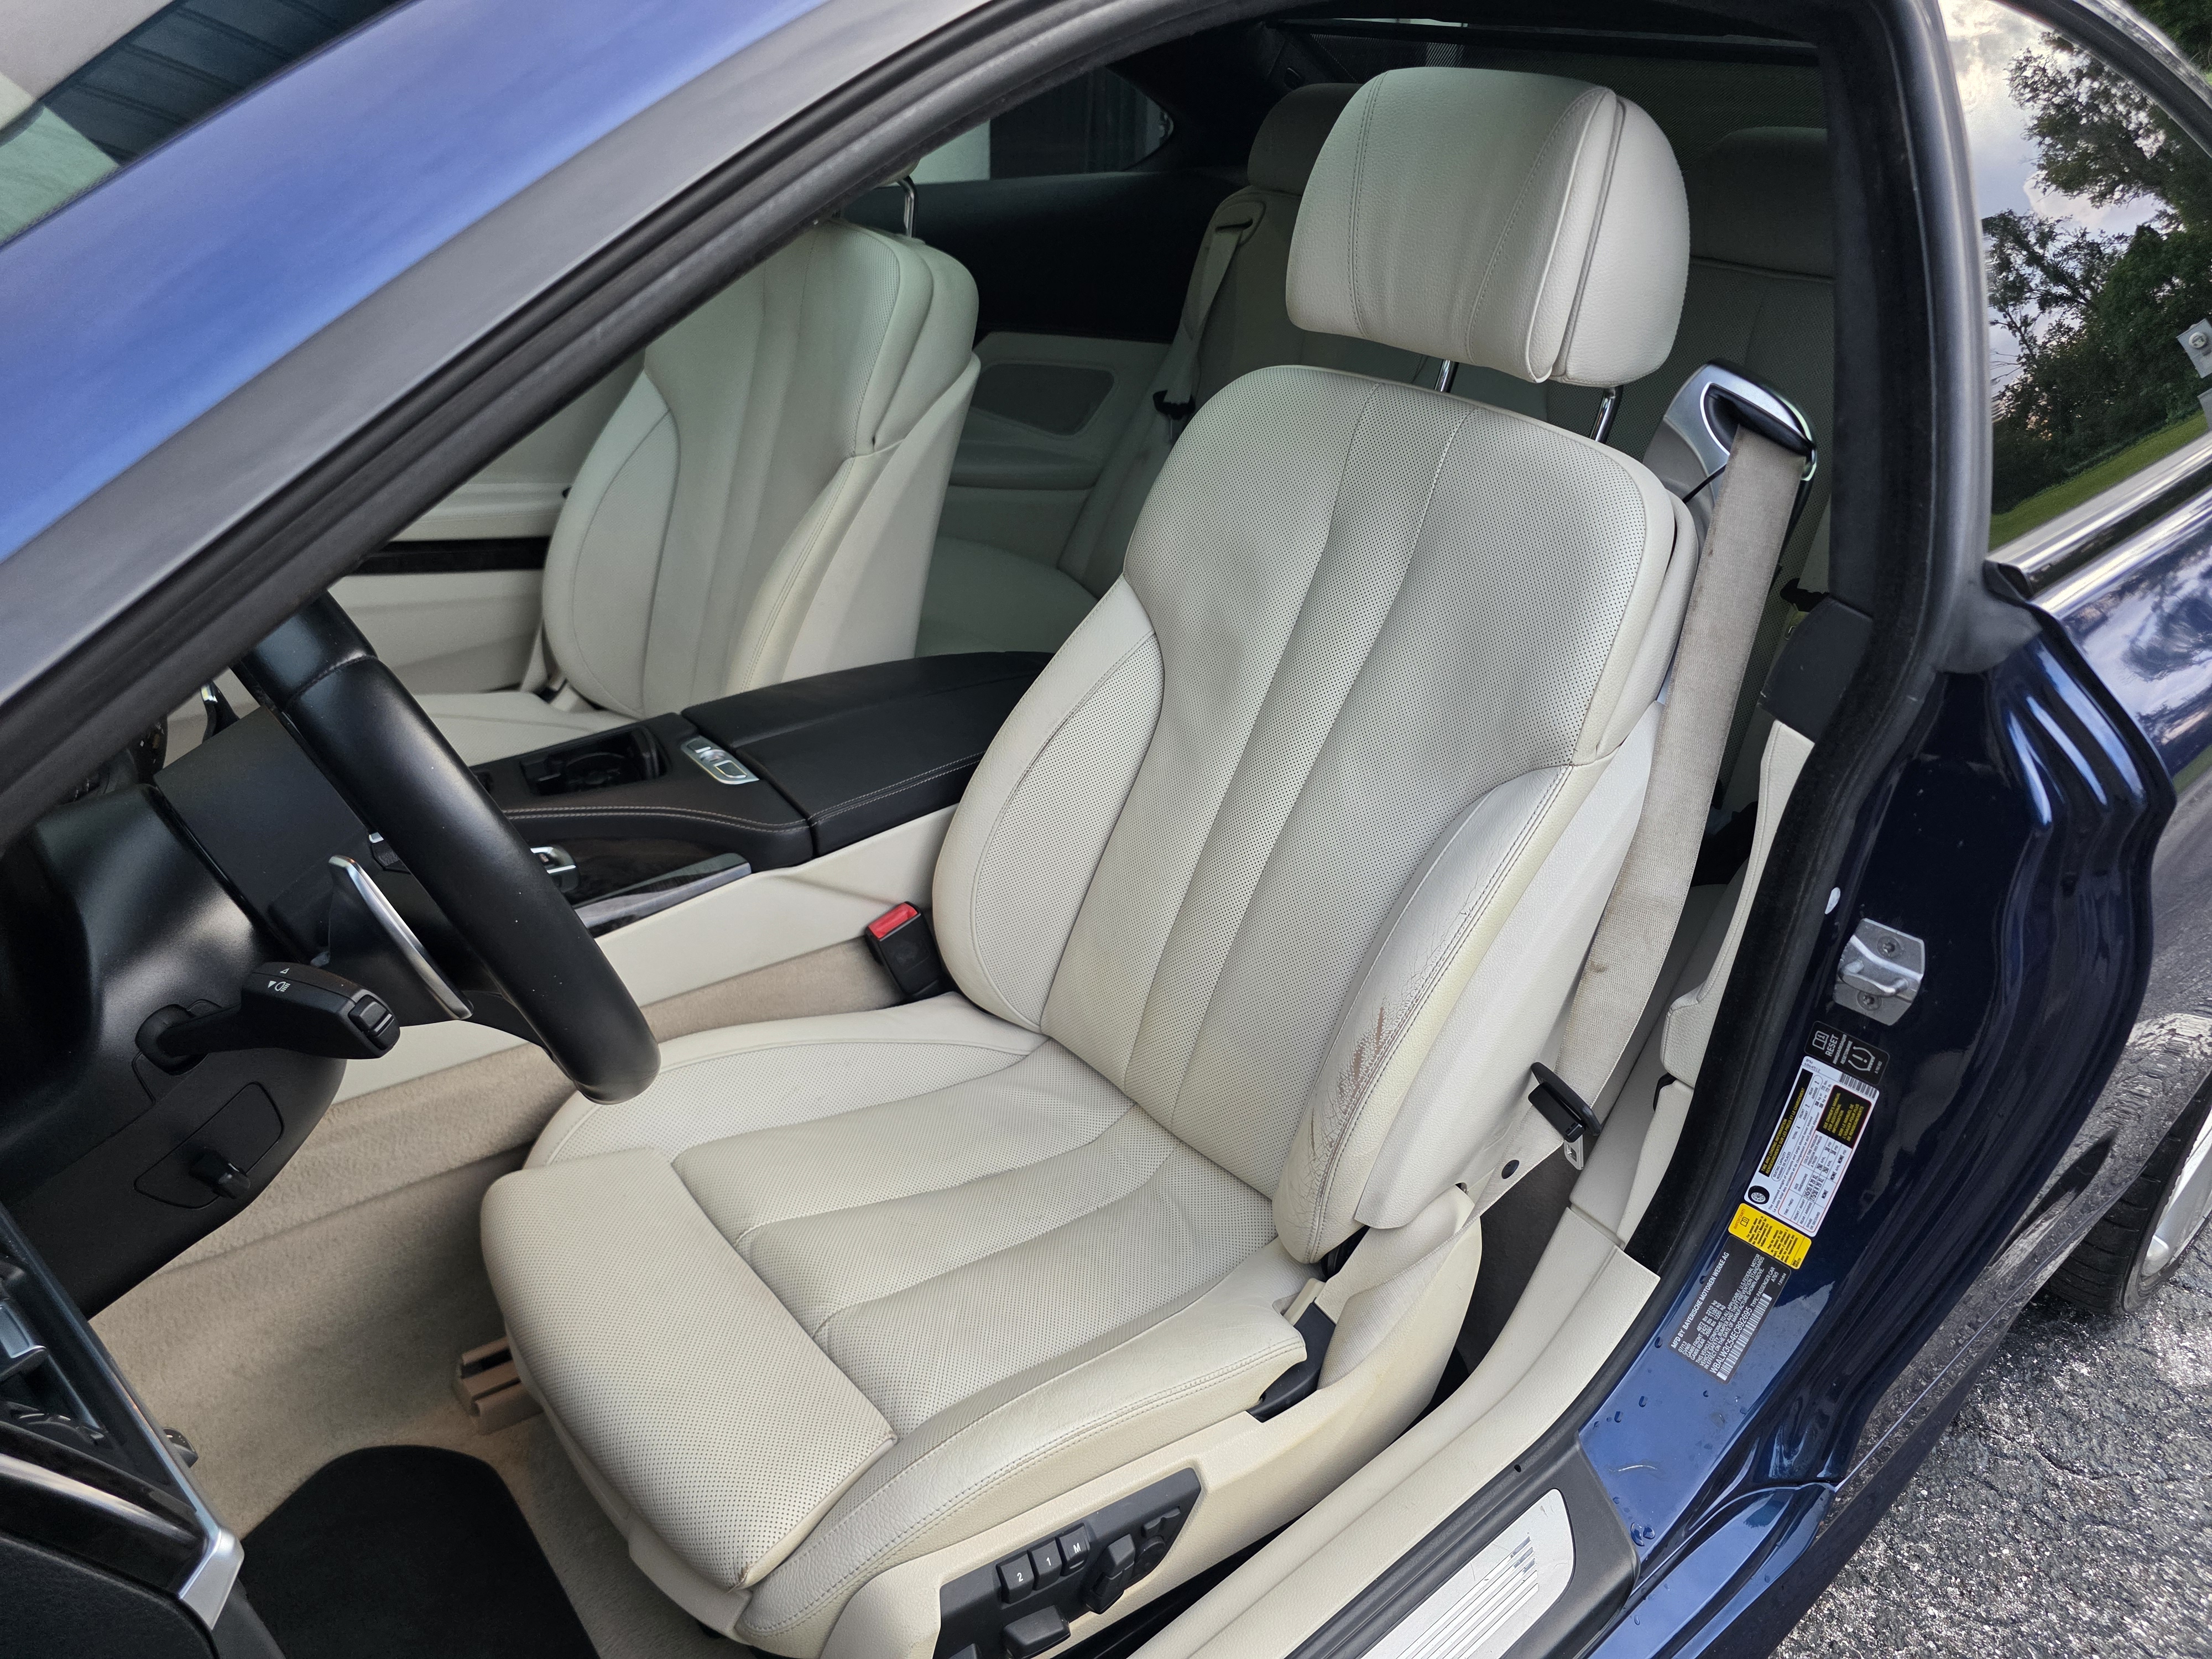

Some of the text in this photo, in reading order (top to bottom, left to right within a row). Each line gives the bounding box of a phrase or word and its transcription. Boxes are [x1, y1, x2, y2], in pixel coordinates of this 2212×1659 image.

[1824, 1034, 1839, 1057] RESET
[1825, 1106, 1835, 1122] OWNER'S
[1832, 1092, 1841, 1107] MANUAL
[1830, 1103, 1841, 1124] ADDITIONAL
[1832, 1109, 1844, 1133] INFORMATION
[1843, 1108, 1852, 1123] MANUEL
[1848, 1105, 1864, 1136] RENSEIGNEMENTS
[1765, 1144, 1781, 1174] RENSEIGNEMENTS
[1793, 1087, 1805, 1110] CHARGEMENT
[1768, 1141, 1777, 1156] LOADING
[1775, 1118, 1787, 1141] INFORMATION
[1809, 1134, 1818, 1149] PRESSURE
[1778, 1151, 1786, 1165] CAPACITY
[1733, 1208, 1745, 1229] IMPORTANT!
[1671, 1251, 1729, 1348] MFD BY BAYERISCHE MOTOREN WERKE AG
[1750, 1295, 1759, 1307] TYPE:
[1756, 1274, 1771, 1297] PASSENGER
[1695, 1354, 1703, 1364] THIS
[1700, 1339, 1712, 1356] VEHICLE
[1708, 1321, 1723, 1342] CONFORMS
[1726, 1288, 1741, 1311] APPLICABLE
[1750, 1253, 1761, 1267] MOTOR
[1699, 1350, 1711, 1366] VEHICLE
[1717, 1320, 1729, 1337] BUMPER
[1731, 1300, 1740, 1313] THEFT
[1737, 1277, 1753, 1301] PREVENTION
[1749, 1256, 1765, 1279] STANDARDS
[1706, 1350, 1717, 1365] EFFECT
[1722, 1327, 1731, 1338] DATE
[1731, 1294, 1749, 1322] MANUFACTURE
[1746, 1280, 1757, 1295] SHOWN
[1753, 1266, 1765, 1282] ABOVE.
[1682, 1342, 1692, 1355] GVWR
[1696, 1321, 1704, 1332] 4872
[1705, 1305, 1714, 1316] 2210
[1686, 1345, 1695, 1358] GAWR
[1693, 1333, 1703, 1347] FRONT
[1700, 1323, 1709, 1334] 2425
[1709, 1307, 1718, 1318] 1100
[1690, 1347, 1699, 1360] GAWR
[1697, 1338, 1705, 1349] REAR
[1704, 1326, 1713, 1337] 2690
[1714, 1310, 1722, 1321] 1220
[1709, 1306, 1752, 1374] WBALW3C54EC892695
[1677, 1340, 1687, 1353] 07/13
[1046, 1557, 1051, 1566] 1
[1073, 1543, 1081, 1553] M
[1017, 1572, 1023, 1582] 2
